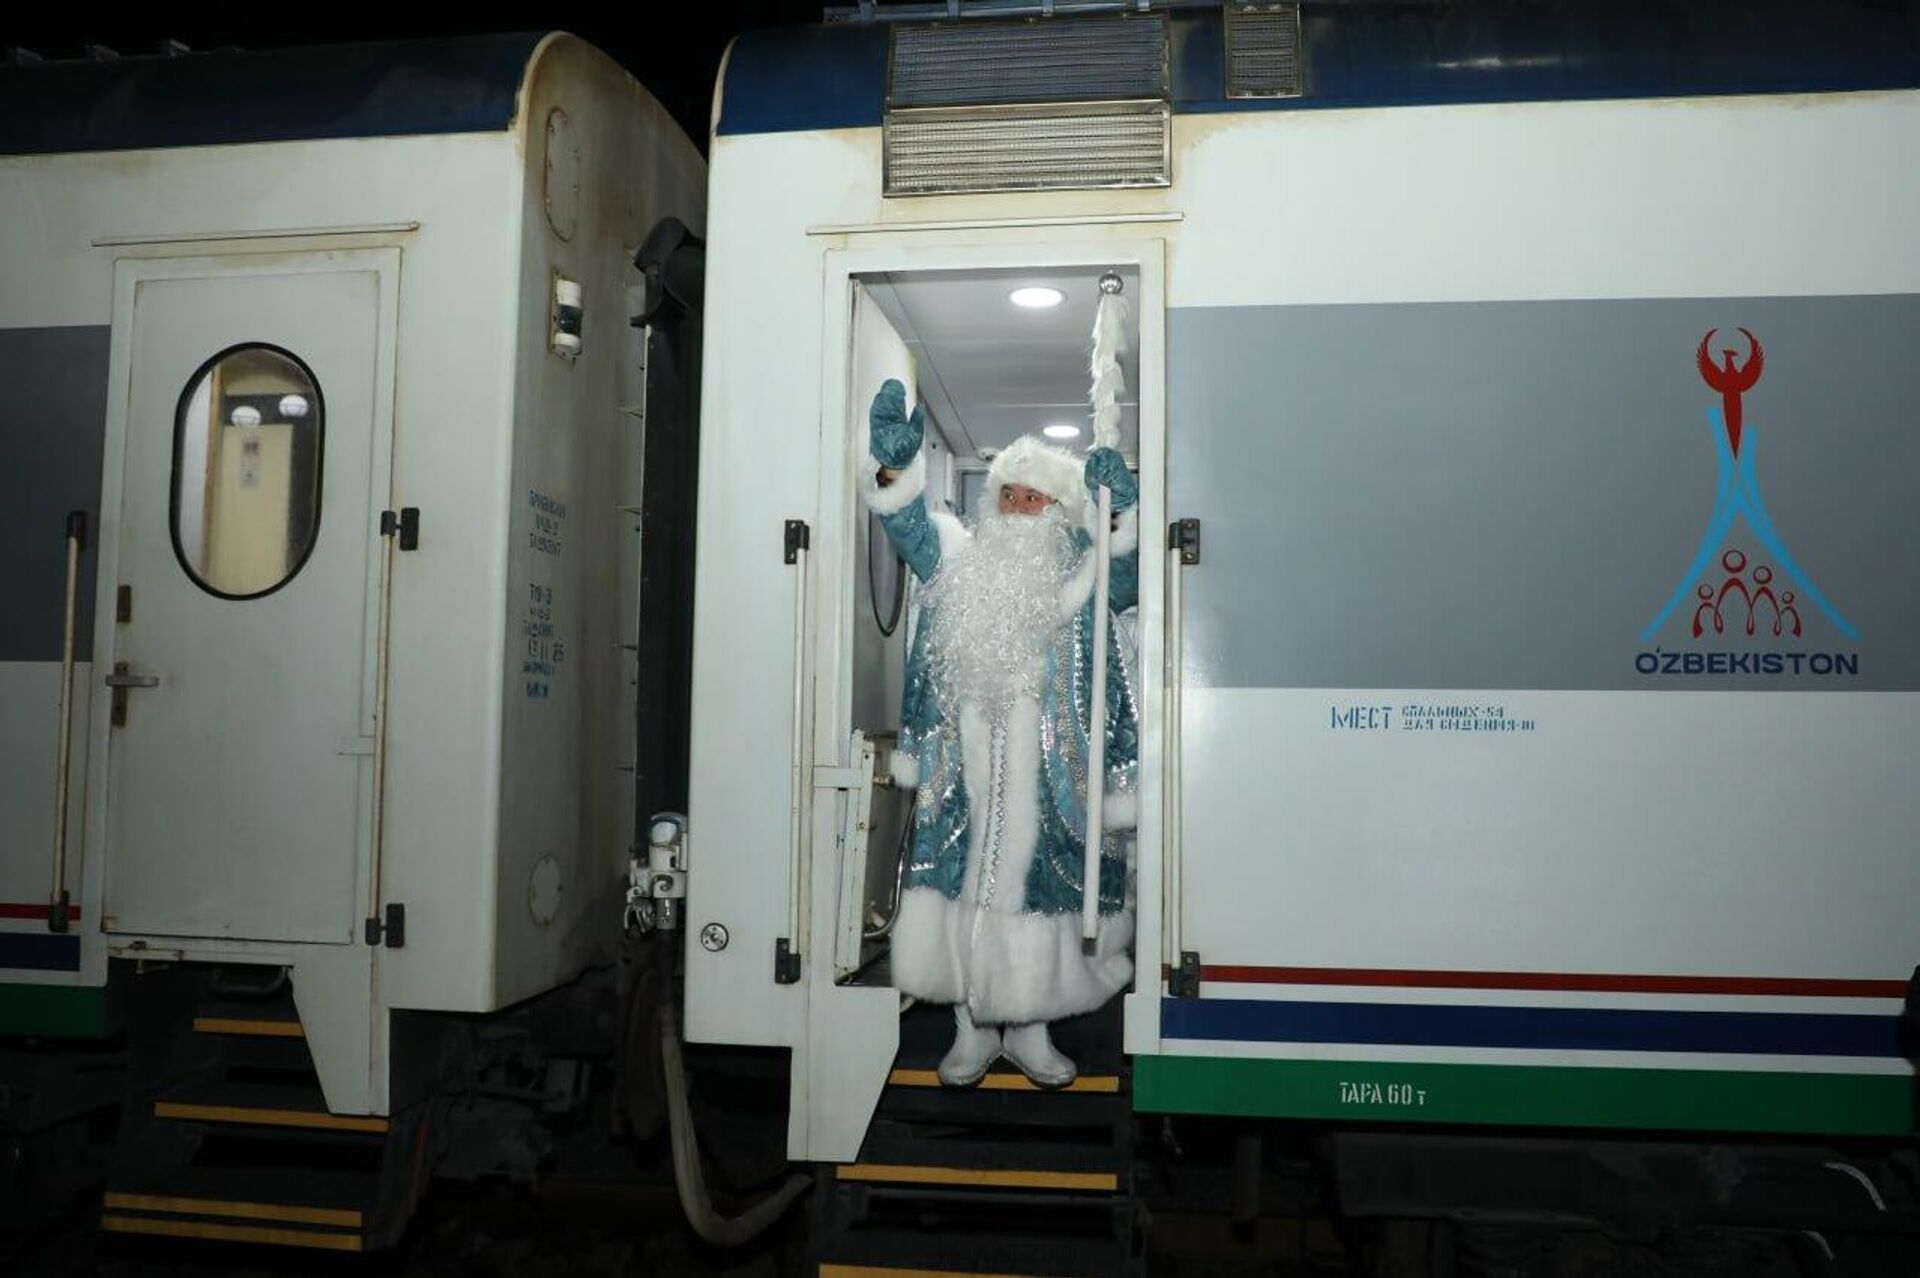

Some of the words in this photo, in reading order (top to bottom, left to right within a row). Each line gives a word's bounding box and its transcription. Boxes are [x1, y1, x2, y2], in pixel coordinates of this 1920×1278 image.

[1332, 706, 1392, 729] МЕСТ
[1339, 1082, 1383, 1103] ТАРА
[1387, 1083, 1412, 1105] 60
